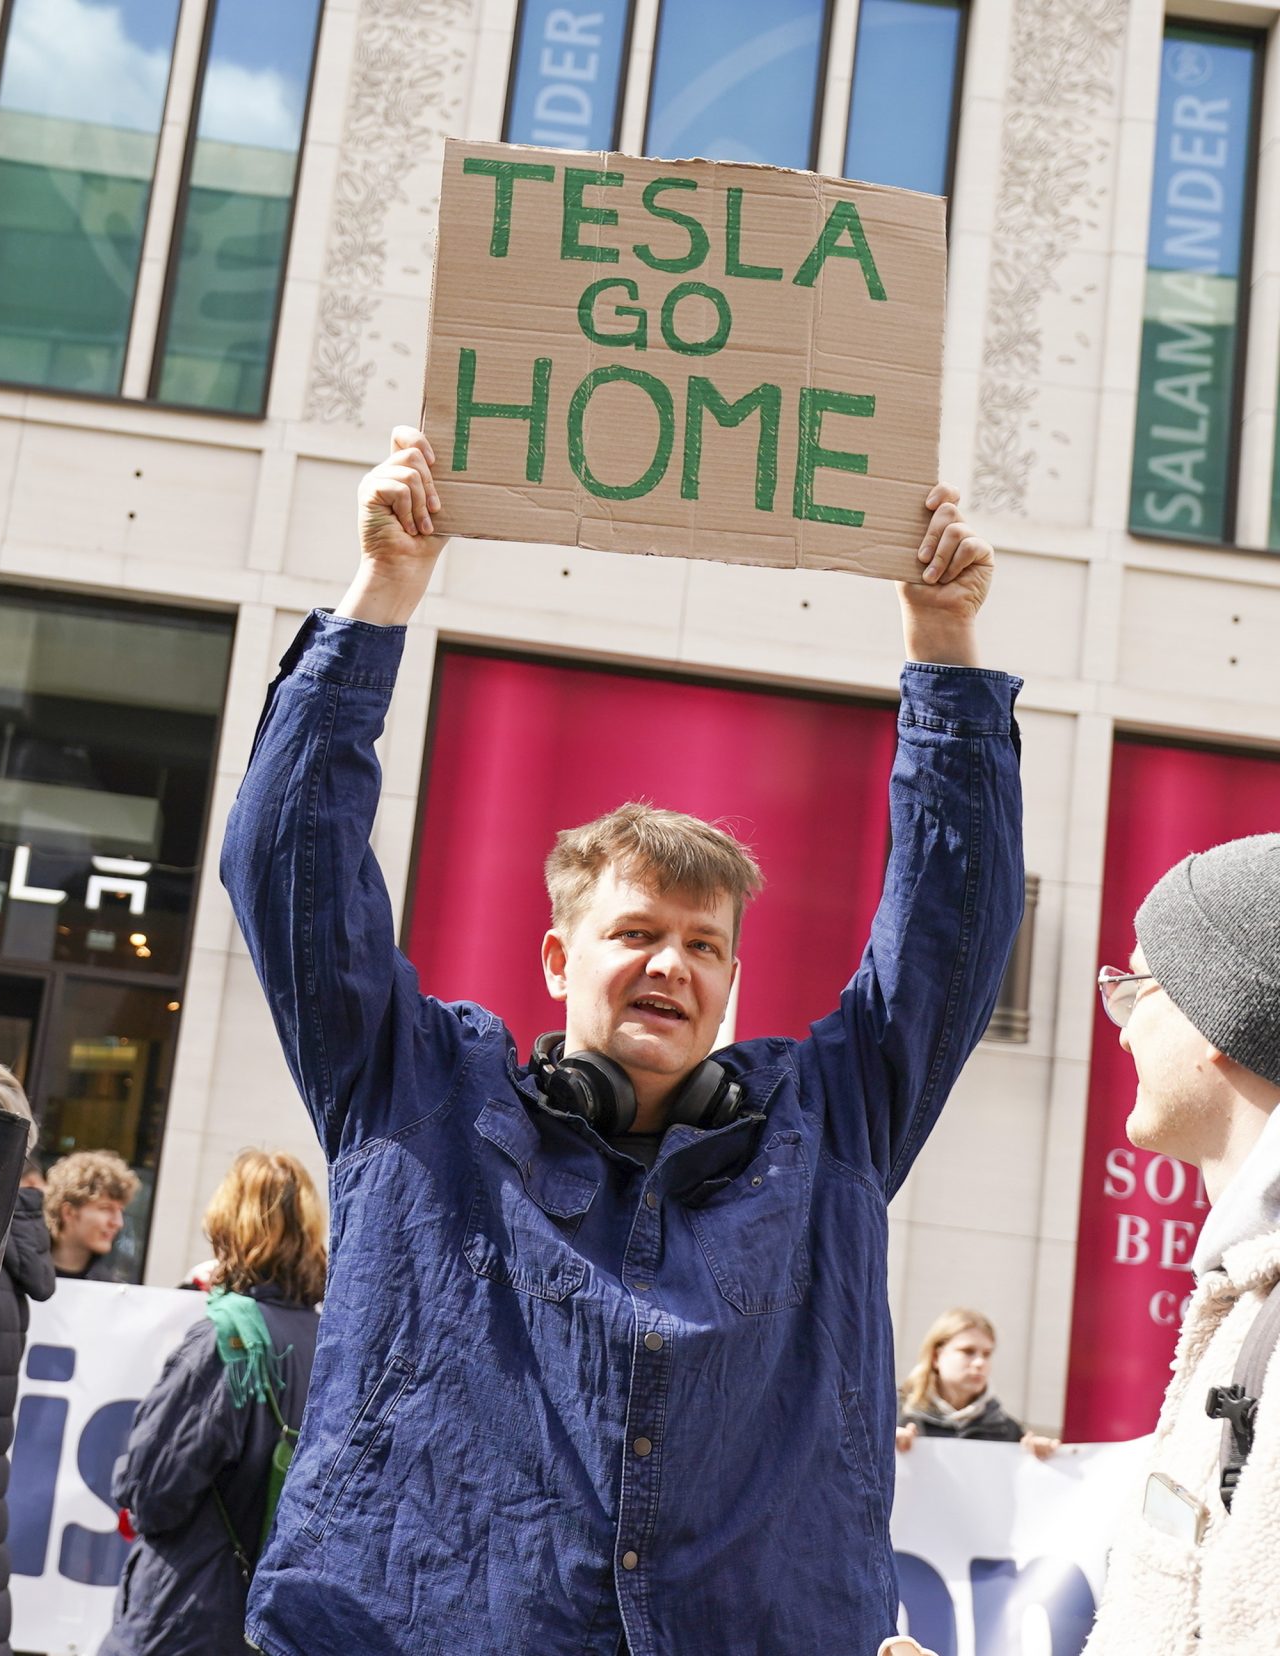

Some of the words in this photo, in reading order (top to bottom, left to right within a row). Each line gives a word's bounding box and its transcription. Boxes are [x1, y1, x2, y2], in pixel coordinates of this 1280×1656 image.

[462, 158, 888, 302] TESLA
[577, 278, 732, 356] GO
[1144, 94, 1231, 527] SALAMANDER
[452, 347, 876, 527] HOME
[1149, 1290, 1193, 1326] C
